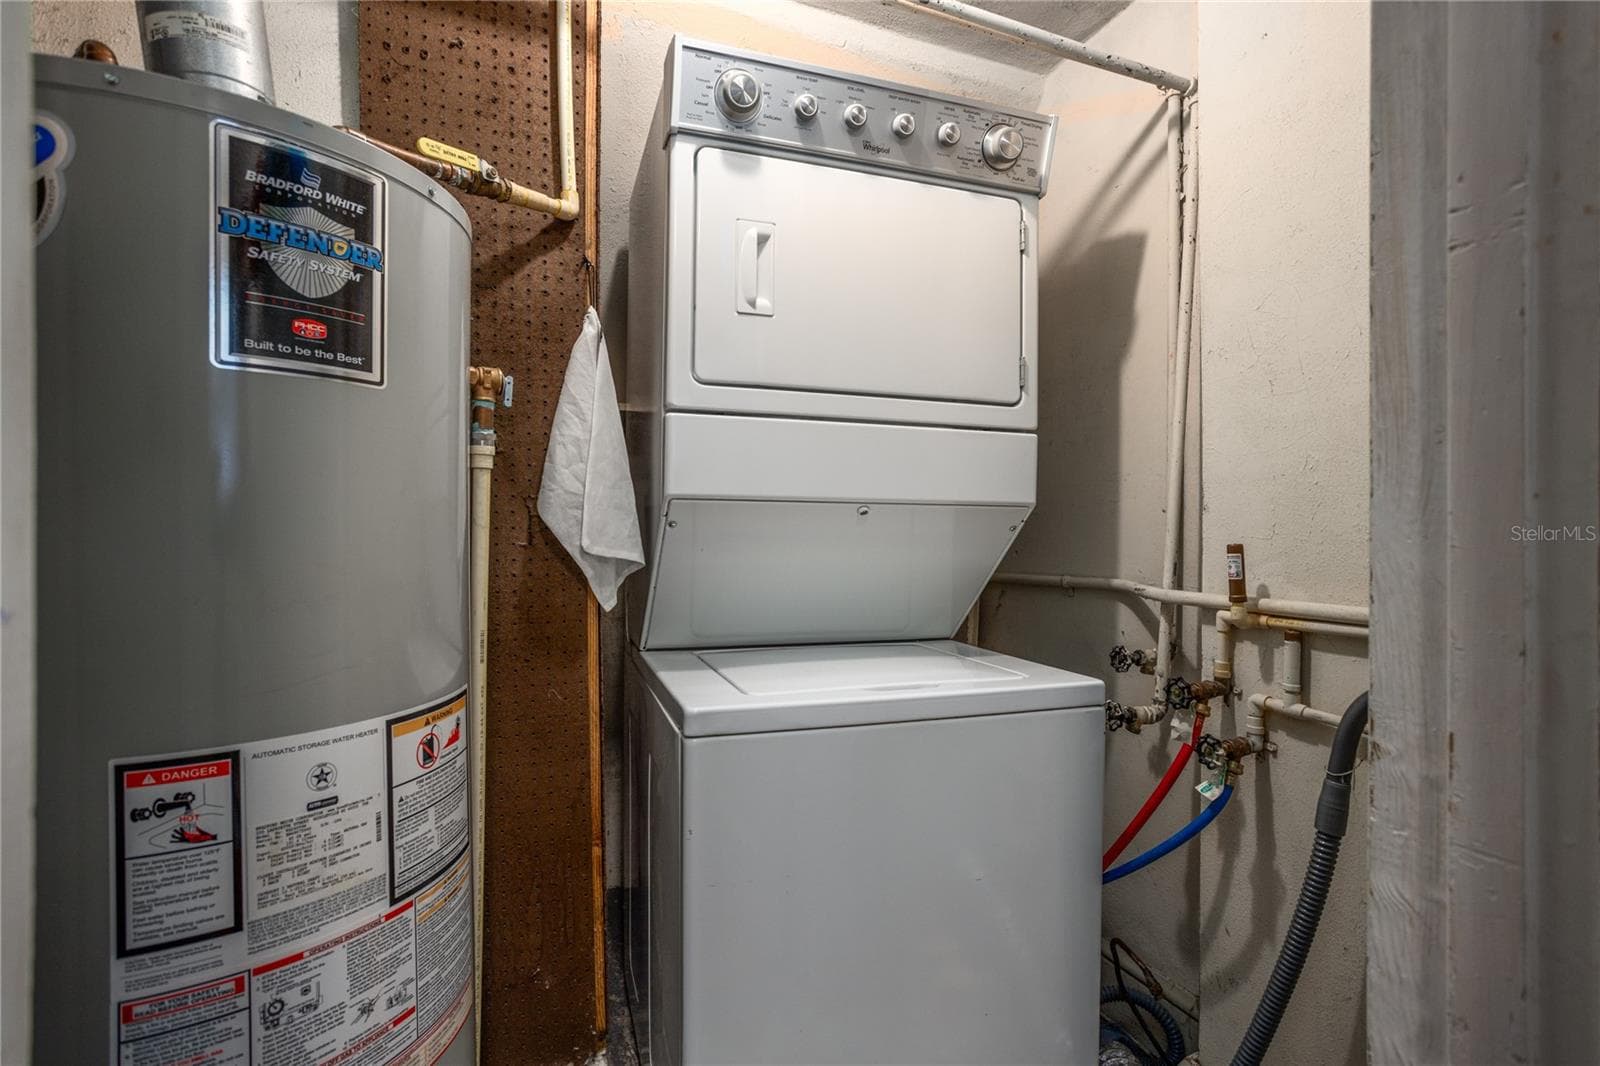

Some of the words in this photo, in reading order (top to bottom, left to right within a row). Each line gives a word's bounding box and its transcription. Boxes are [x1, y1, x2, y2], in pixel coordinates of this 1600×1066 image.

[862, 143, 891, 154] Whirlpool
[244, 170, 322, 200] BRADFORD
[326, 192, 367, 215] WHITE
[218, 206, 384, 272] DEFENDER
[247, 246, 305, 266] SAFETY
[308, 259, 362, 283] SYSTEM
[294, 320, 326, 333] PHCC
[244, 338, 274, 353] Built
[277, 344, 292, 354] to
[295, 344, 311, 357] be
[315, 349, 334, 360] the
[337, 352, 363, 366] Best
[252, 746, 296, 760] AUTOMATIC
[298, 740, 332, 752] STORAGE
[332, 733, 354, 744] WATER
[355, 728, 378, 738] HEATER
[161, 764, 218, 782] DANGER
[179, 814, 200, 823] HOT
